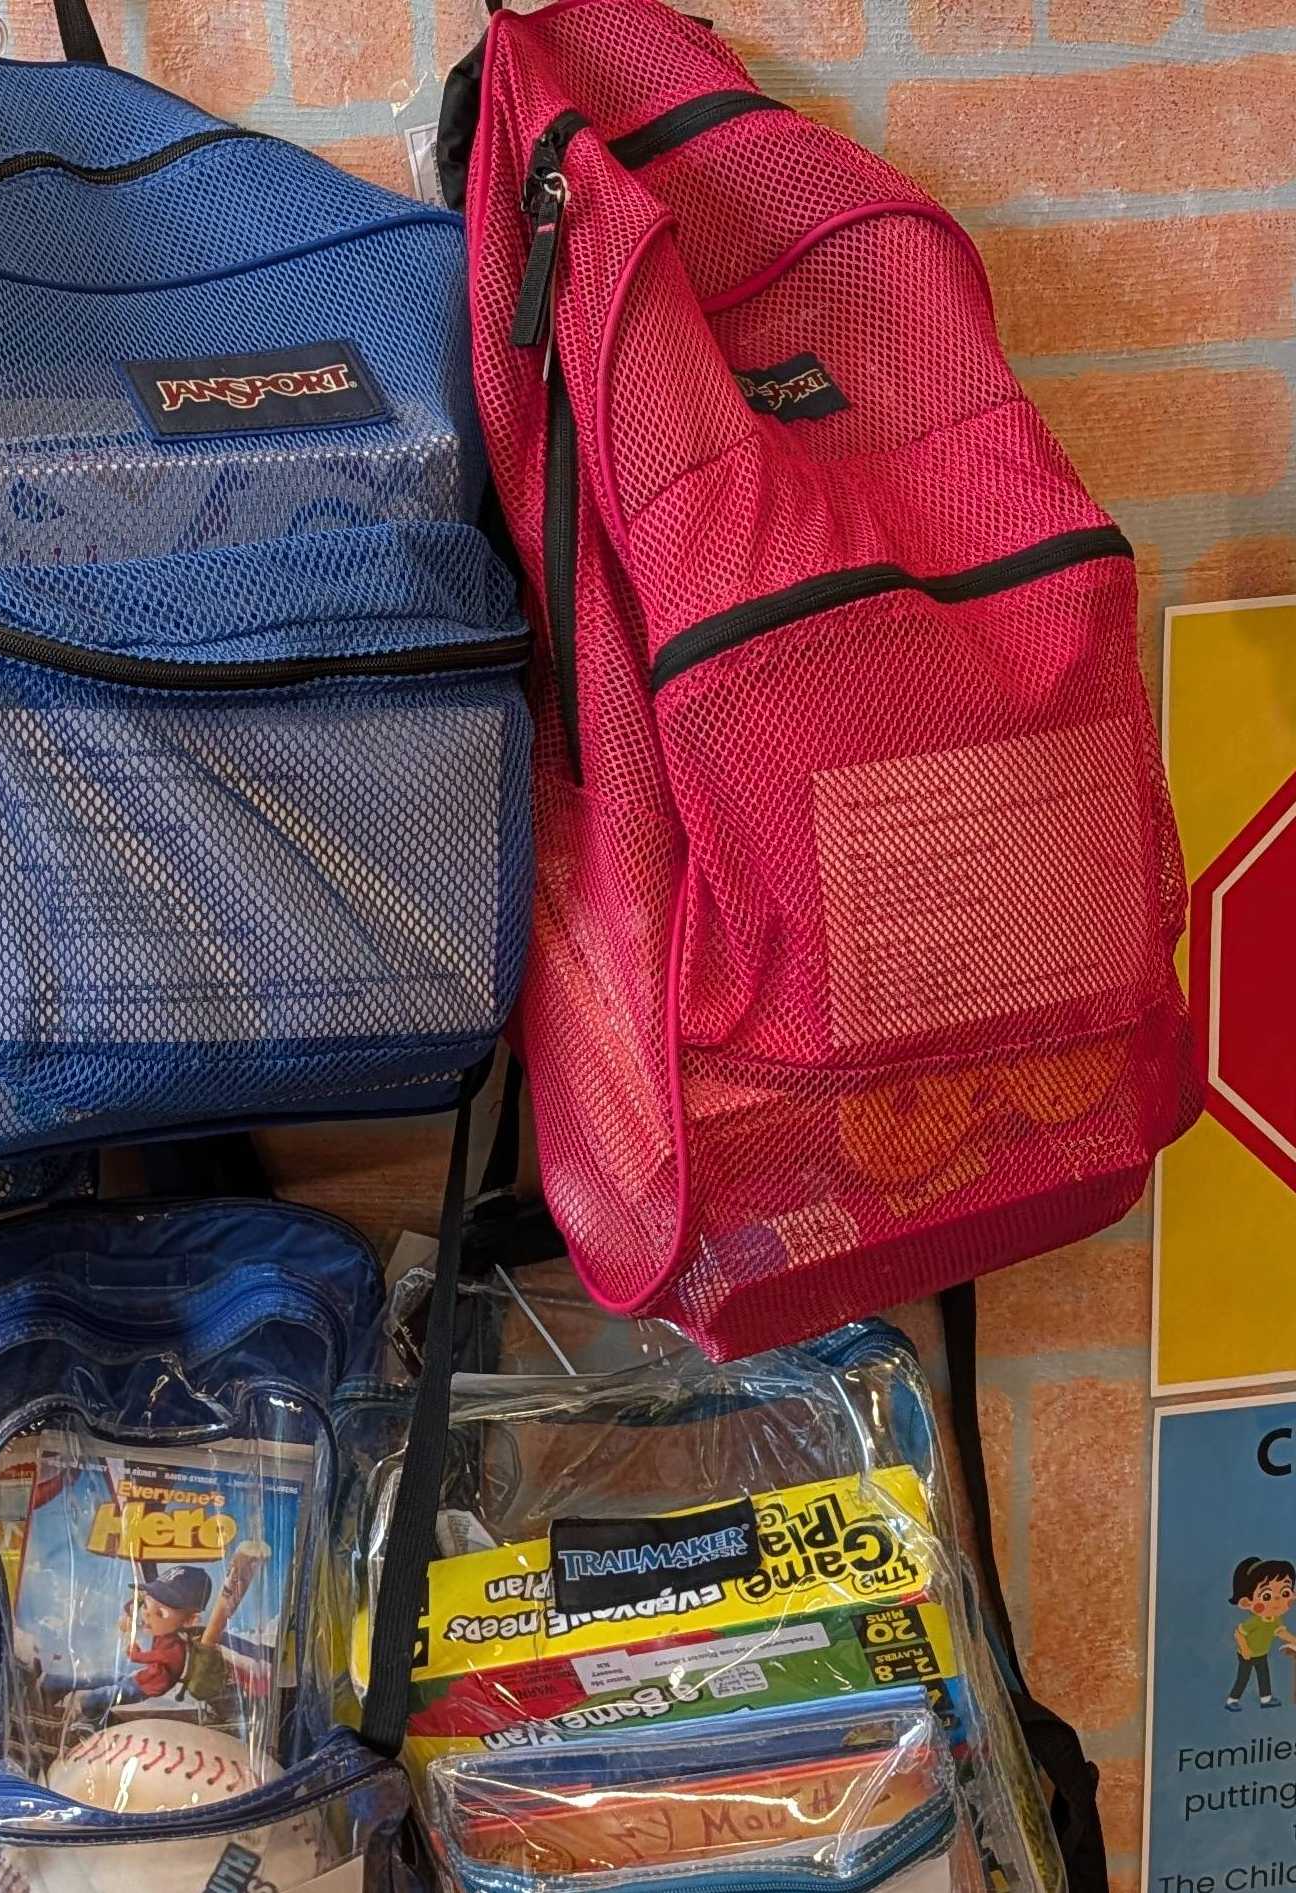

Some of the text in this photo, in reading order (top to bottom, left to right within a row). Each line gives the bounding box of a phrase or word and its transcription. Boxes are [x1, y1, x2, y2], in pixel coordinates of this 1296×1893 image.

[157, 364, 352, 411] JANSPORT
[118, 1480, 225, 1507] Everyone's
[88, 1502, 237, 1560] Hero
[761, 1502, 840, 1558] Pla
[559, 1527, 748, 1581] TRAILMAKER
[674, 1546, 748, 1569] CLASSIC
[744, 1525, 894, 1600] Game
[859, 1564, 908, 1590] The
[867, 1618, 917, 1643] 20
[876, 1648, 924, 1664] PLAYERS
[560, 1687, 671, 1729] game
[1179, 1737, 1296, 1772] Familie
[1185, 1781, 1296, 1821] putting
[1158, 1874, 1215, 1893] The
